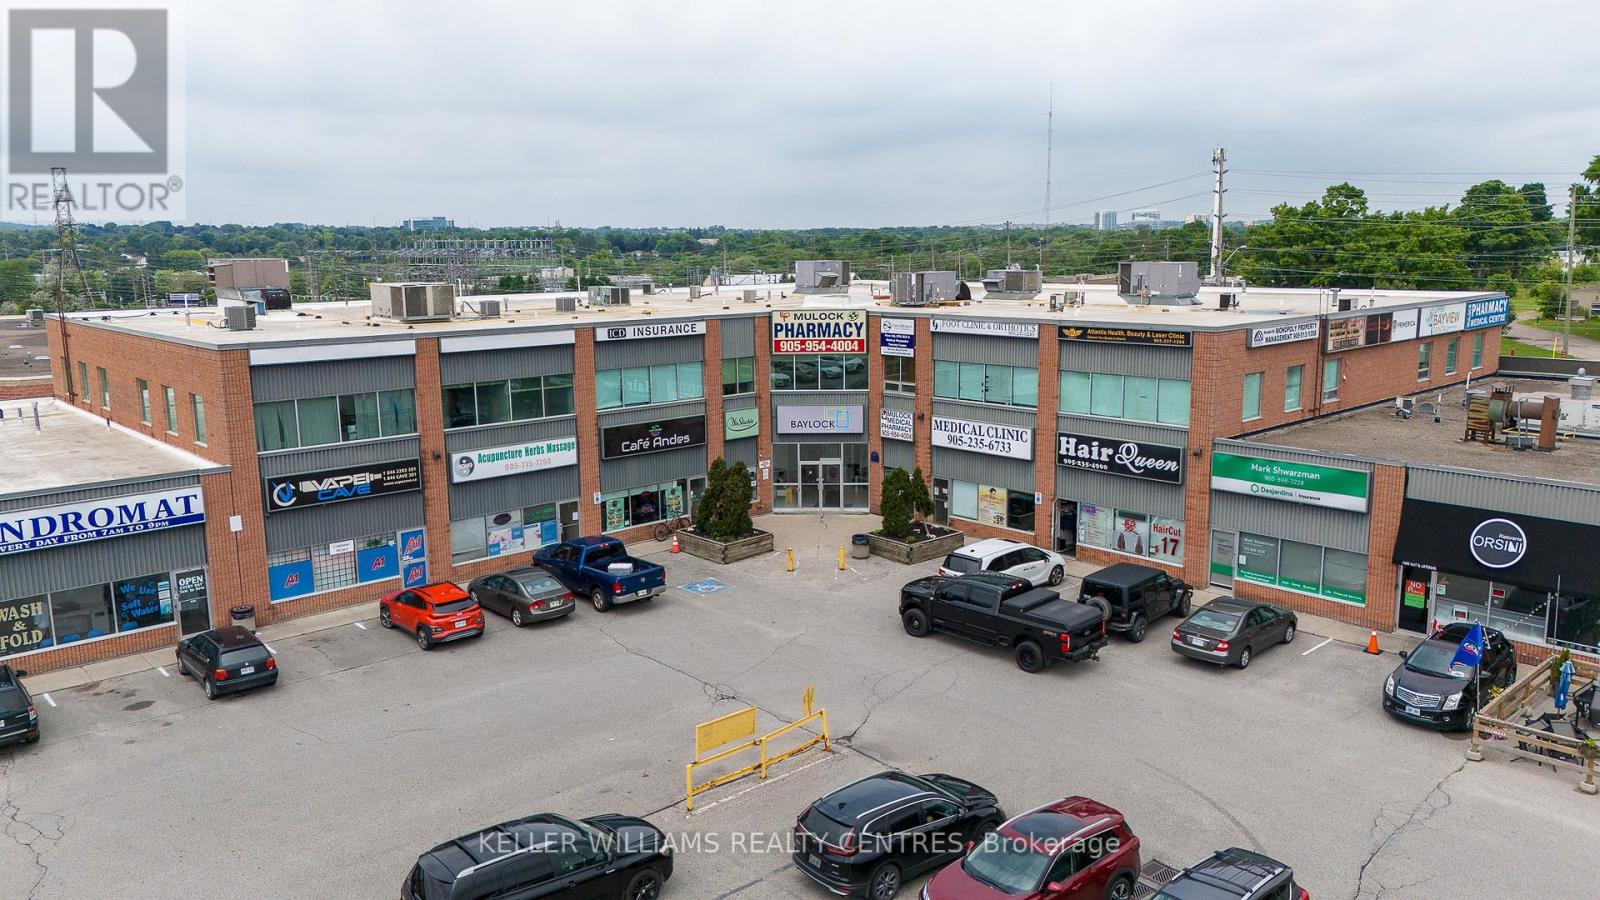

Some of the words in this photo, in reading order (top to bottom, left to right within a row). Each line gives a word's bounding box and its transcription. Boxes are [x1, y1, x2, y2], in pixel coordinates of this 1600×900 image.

[1471, 299, 1508, 317] PHARMACY
[793, 313, 844, 321] MULOCK
[1433, 311, 1461, 325] BAYVIEW
[633, 323, 697, 337] INSURANCE
[774, 322, 864, 339] PHARMACY
[962, 321, 987, 330] CLINIC
[993, 322, 1036, 333] ORTHOTICS
[780, 339, 859, 351] 905-954-4004
[791, 420, 836, 429] BAYLOCK
[934, 419, 985, 437] MEDICAL
[987, 426, 1028, 443] CLINIC
[622, 437, 650, 452] Café
[653, 434, 690, 448] Andes
[947, 434, 1012, 453] 905-235-6733
[477, 448, 523, 464] Acupuncture
[525, 445, 545, 457] Herbs
[547, 440, 576, 454] Massage
[1059, 436, 1114, 462] Hair
[1115, 443, 1179, 474] Queen
[1251, 463, 1271, 472] Mark
[1273, 466, 1320, 480] Shwarzman
[318, 484, 371, 501] CAVE
[1261, 486, 1294, 497] Desjardins
[36, 536, 61, 548] DAY
[63, 530, 98, 542] FROM
[101, 526, 125, 536] 7AM
[128, 523, 144, 532] TO
[148, 519, 170, 529] 9PM
[1152, 523, 1182, 537] HairCut
[1473, 535, 1523, 554] ORSINI
[179, 575, 203, 586] OPEN
[120, 584, 137, 595] We
[139, 586, 159, 597] Use
[121, 599, 142, 612] Soft
[131, 605, 159, 619] Water
[13, 619, 27, 631] &
[0, 630, 43, 652] FOLD
